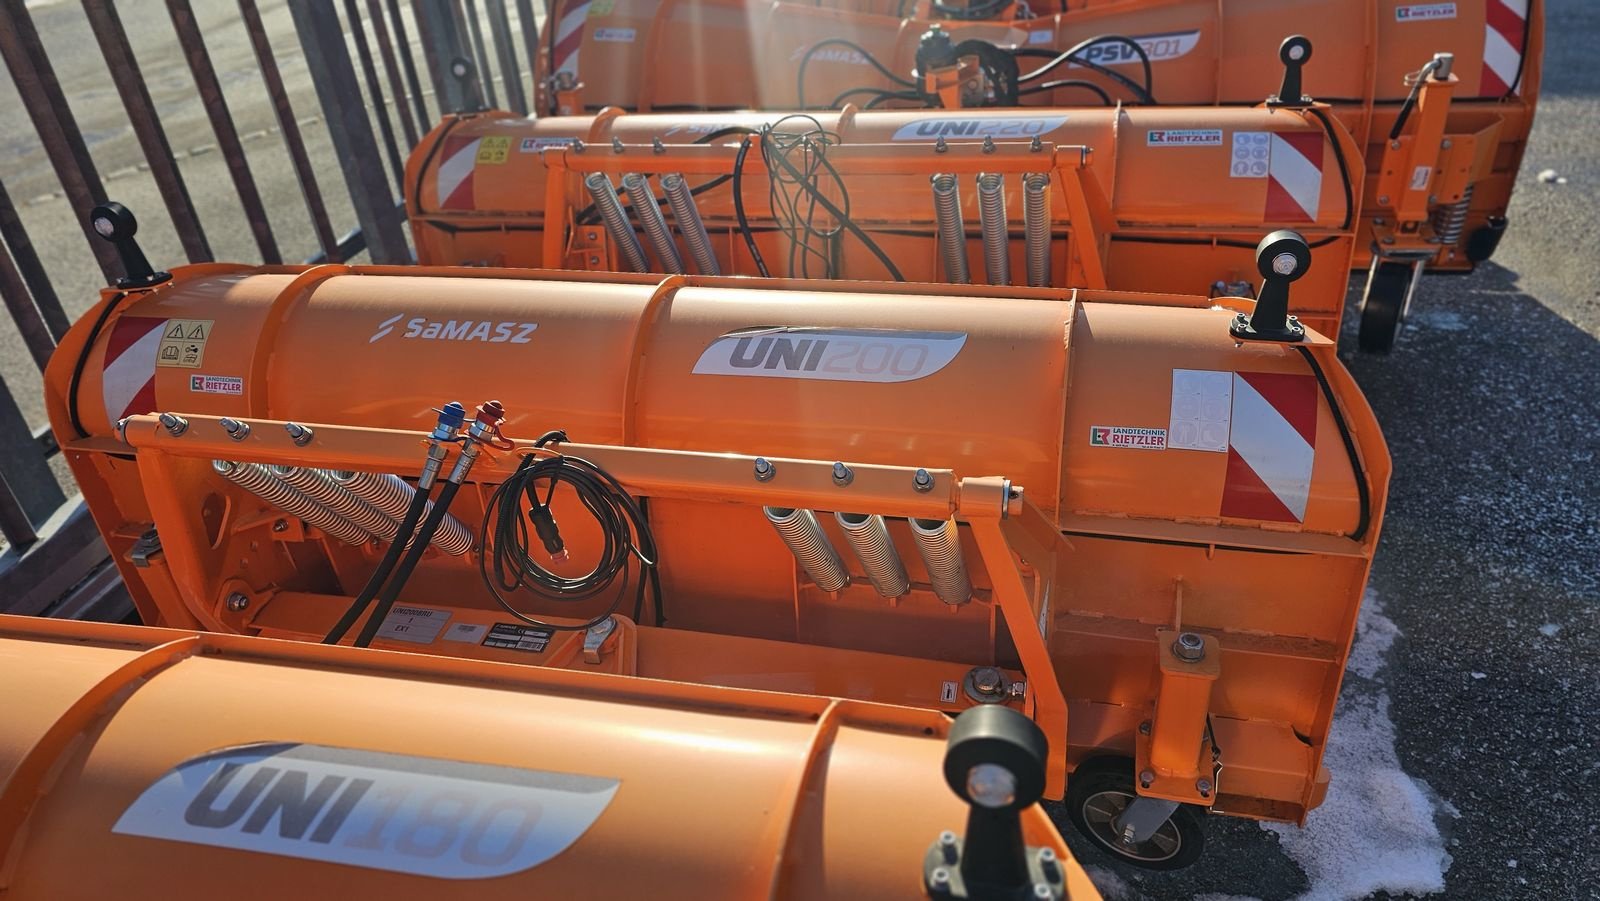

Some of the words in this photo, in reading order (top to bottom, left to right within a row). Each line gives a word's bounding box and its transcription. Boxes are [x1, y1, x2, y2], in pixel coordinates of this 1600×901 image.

[915, 120, 1046, 136] UNI220
[402, 317, 539, 344] SaMASZ
[729, 336, 929, 376] UNI200
[205, 382, 241, 392] RIETZLER
[1112, 434, 1165, 446] RIETZLER
[1113, 428, 1166, 436] LANDTECHNIK
[183, 761, 545, 868] UNI180
